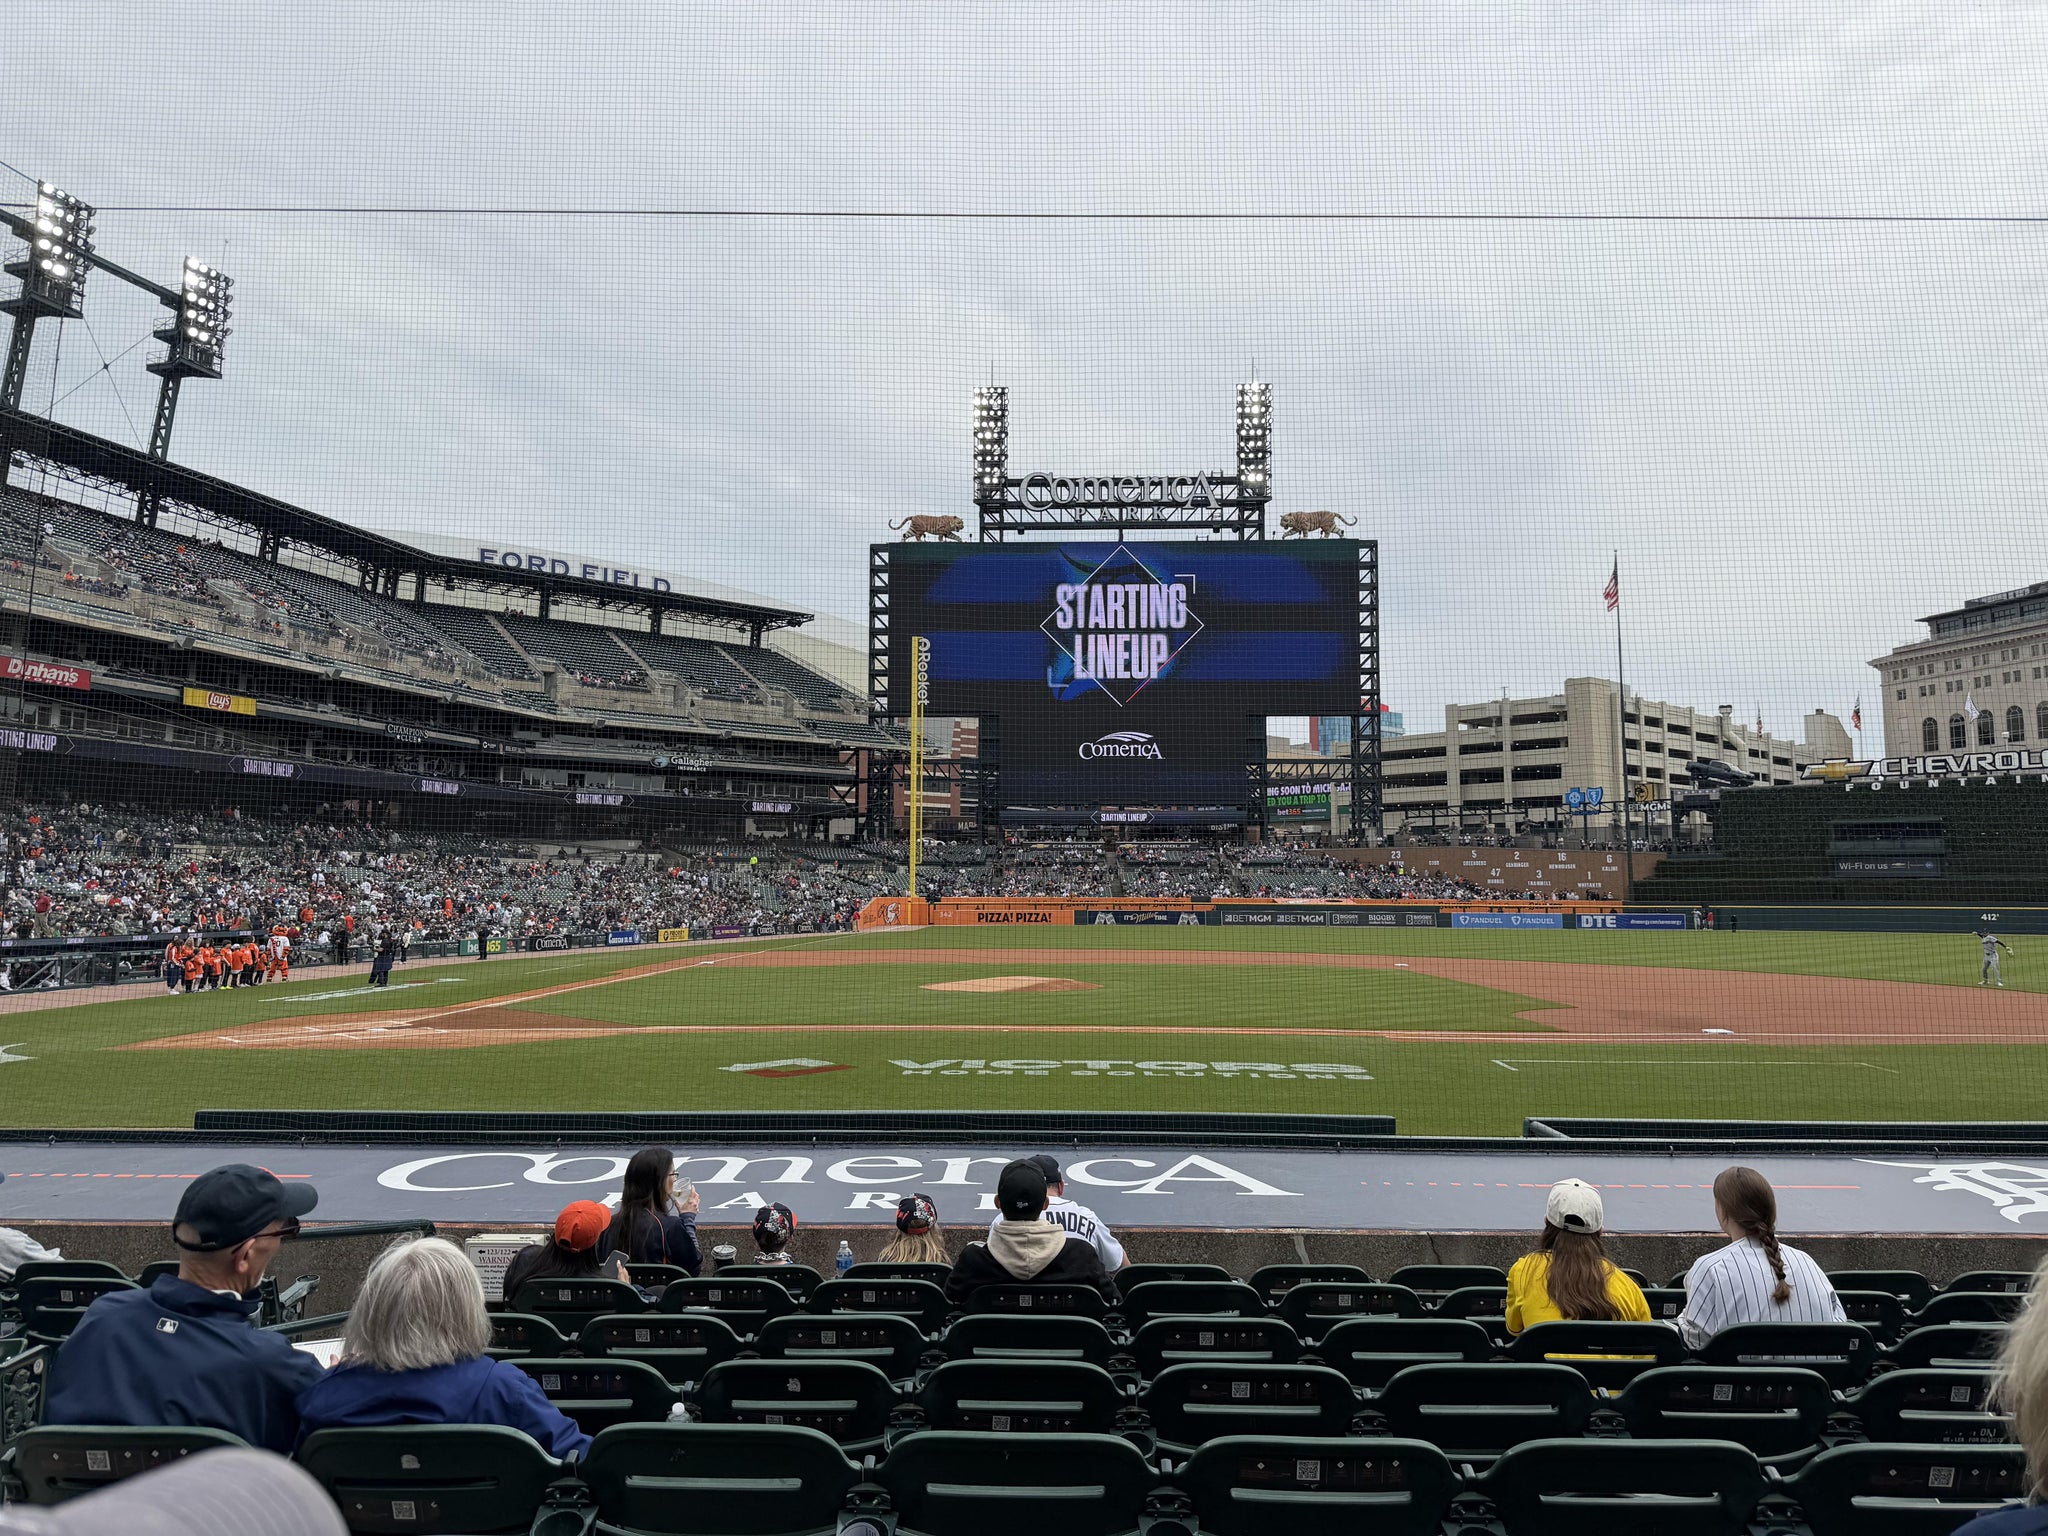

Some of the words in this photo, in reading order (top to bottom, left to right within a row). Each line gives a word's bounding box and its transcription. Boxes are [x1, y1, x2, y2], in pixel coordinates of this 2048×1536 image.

[1074, 507, 1166, 521] PARK
[480, 548, 570, 576] FORD
[582, 563, 671, 592] FIELD
[1056, 583, 1187, 629] STARTING
[1074, 633, 1169, 679] LINEUP
[7, 657, 79, 684] Dunham's
[918, 652, 931, 706] Rocket
[208, 691, 231, 709] Lay's
[387, 724, 429, 739] CHAMPIONS
[26, 732, 57, 751] LINEUP
[400, 734, 418, 743] CLUB
[670, 756, 713, 767] Gallagher
[243, 758, 272, 776] STARTING
[272, 761, 294, 778] LINEUP
[677, 765, 707, 773] INSURANCE
[421, 779, 443, 794] STARTING
[443, 781, 459, 795] LINEUP
[1280, 785, 1300, 796] SOON
[1302, 783, 1311, 794] TO
[575, 793, 602, 804] STARTING
[603, 794, 624, 805] LINEUP
[1277, 796, 1292, 806] YOU
[1293, 796, 1299, 805] A
[1299, 795, 1316, 805] TRIP
[1316, 794, 1327, 803] TO
[752, 802, 774, 812] STARTING
[775, 803, 792, 813] LINEUP
[1277, 808, 1301, 816] bet365
[1101, 813, 1126, 822] STARTING
[1127, 813, 1148, 822] LINEUP
[1391, 850, 1401, 859] 23
[1471, 850, 1477, 859] 5
[1514, 851, 1520, 860] 2
[1557, 852, 1567, 861] 16
[1606, 854, 1613, 863] 6
[1839, 862, 1863, 870] Wi-Fi
[1490, 868, 1501, 877] 47
[1536, 869, 1542, 879] 3
[1587, 871, 1592, 880] 1
[977, 912, 1013, 923] PIZZA!
[1016, 912, 1052, 923] PIZZA!
[1233, 914, 1272, 923] BETMGM
[1285, 915, 1324, 923] BETMGM
[1581, 915, 1617, 928] DTE
[886, 1059, 1368, 1074] VICTORS
[1070, 1070, 1376, 1081] SOLUTIONS
